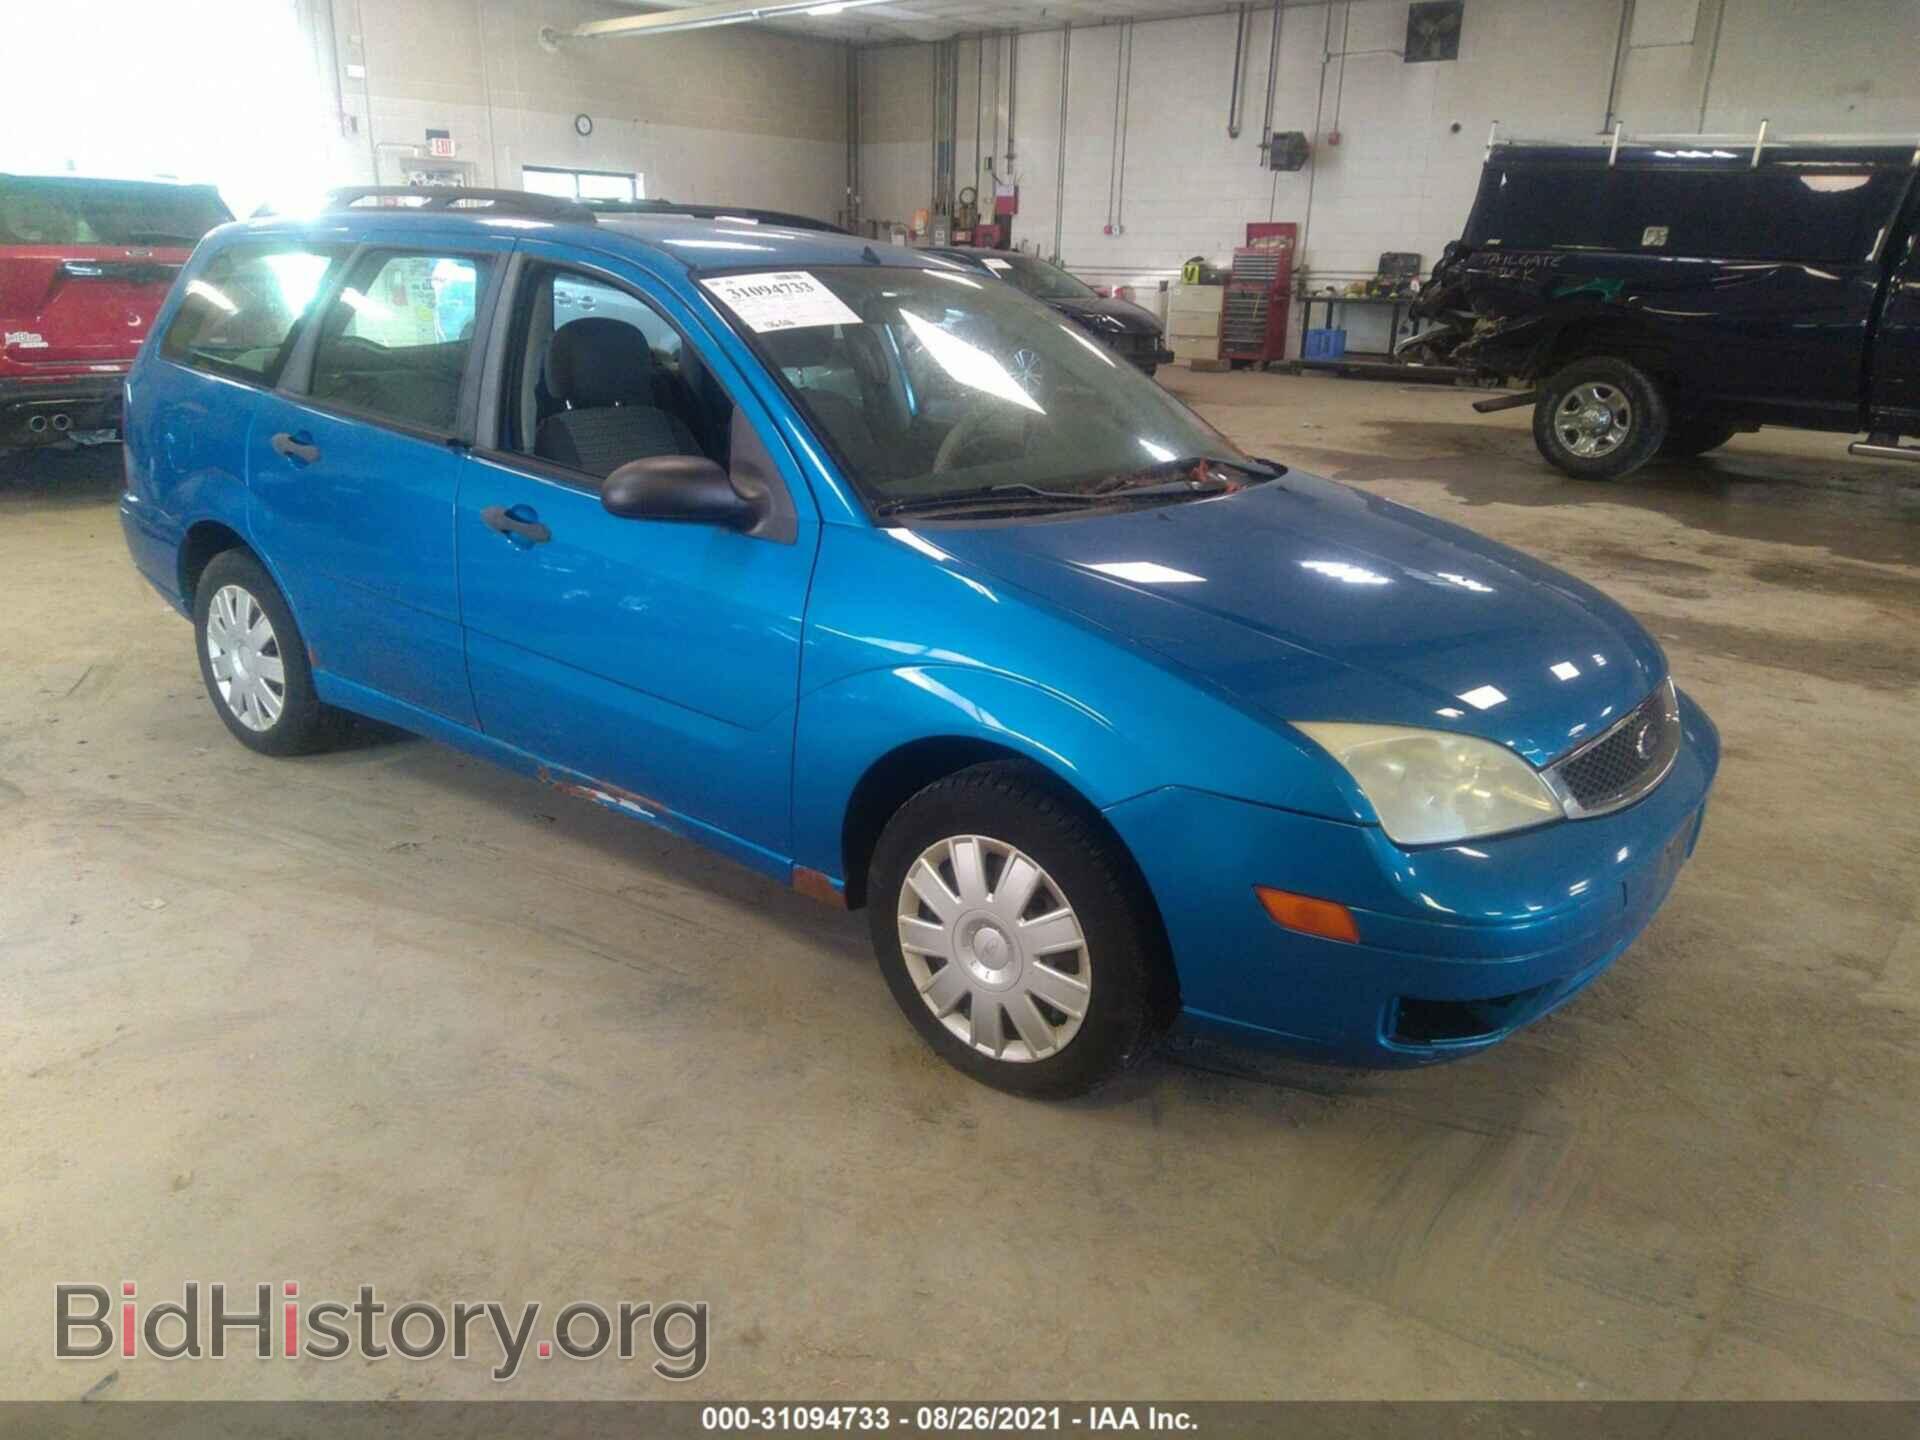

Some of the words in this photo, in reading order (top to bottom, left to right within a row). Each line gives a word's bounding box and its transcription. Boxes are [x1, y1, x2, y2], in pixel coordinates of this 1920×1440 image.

[436, 139, 453, 154] EXIT
[1482, 254, 1566, 268] TAILGATE
[726, 281, 815, 300] 31094733
